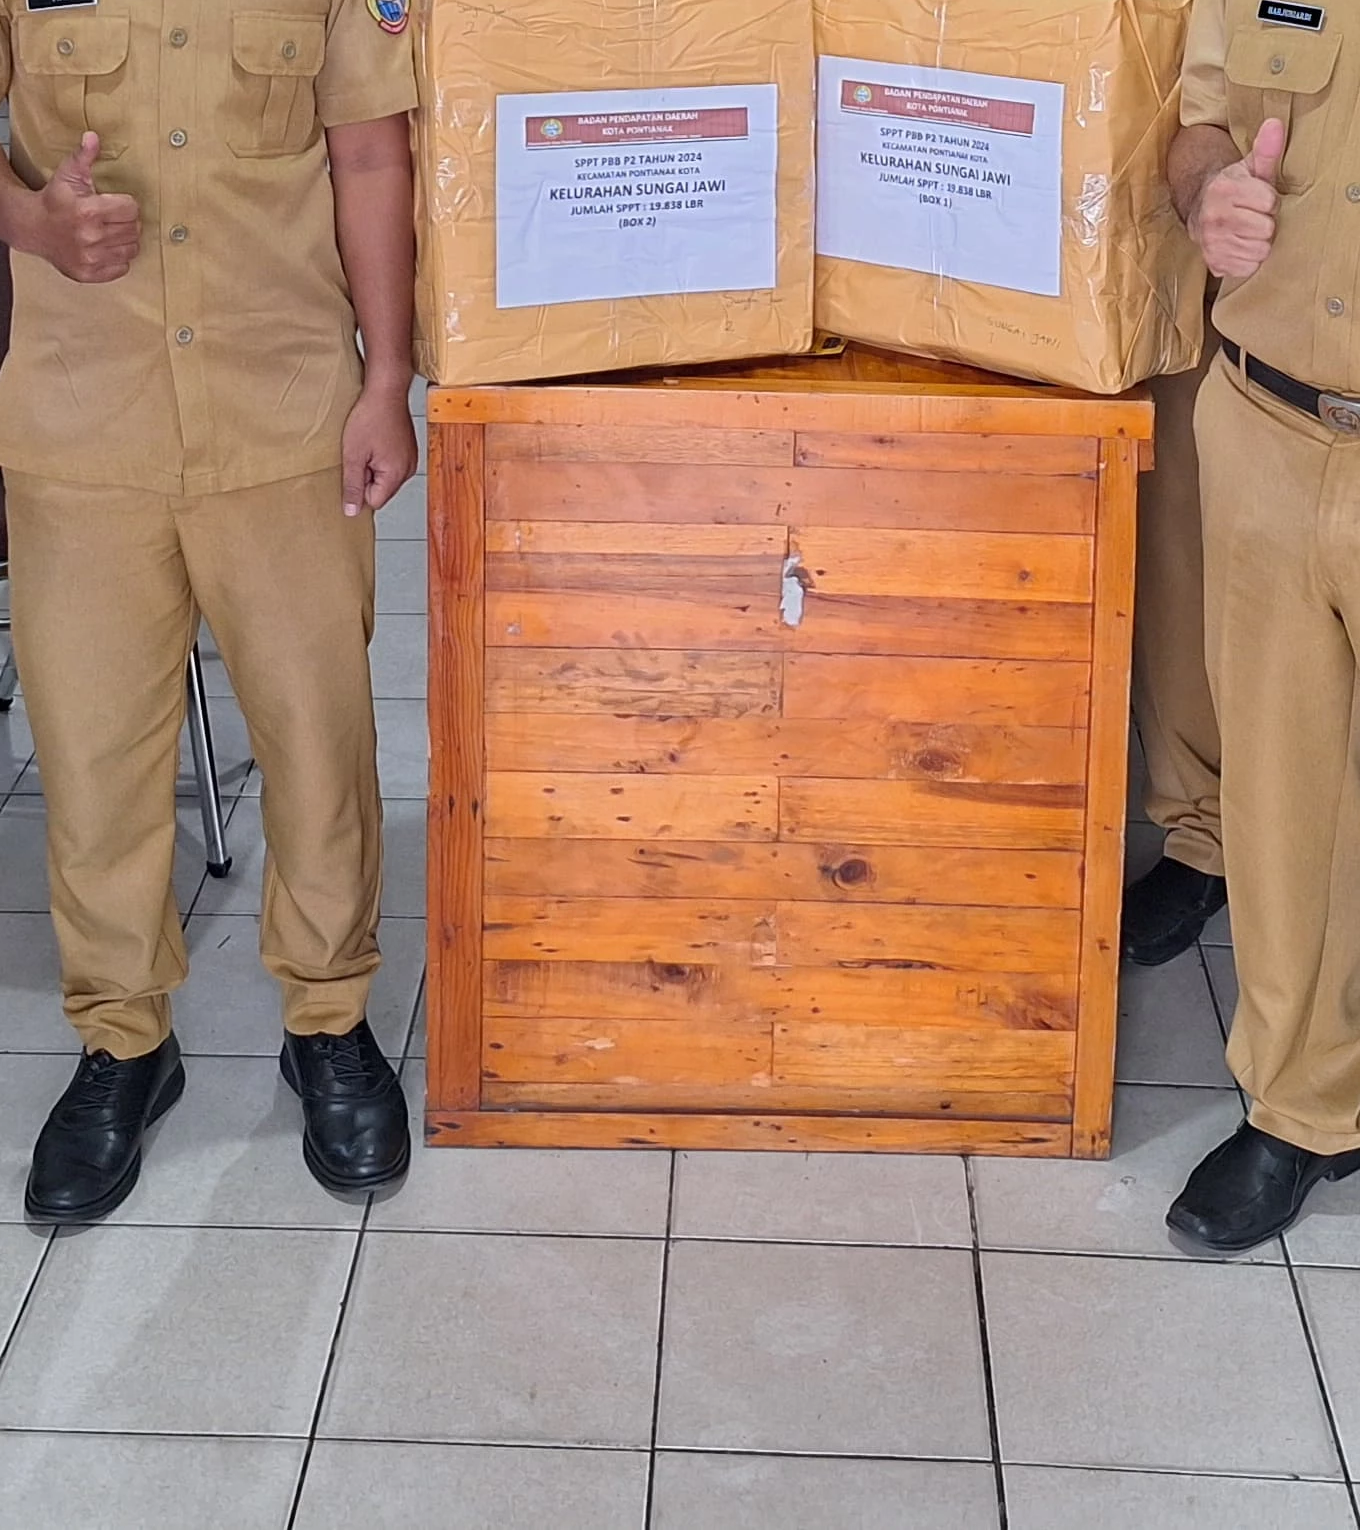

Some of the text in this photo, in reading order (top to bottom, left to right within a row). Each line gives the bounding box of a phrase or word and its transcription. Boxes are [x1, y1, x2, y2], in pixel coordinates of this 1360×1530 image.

[884, 87, 961, 105] BADAN PENDAPATAN
[906, 102, 968, 117] KOTA PONTIANAK
[578, 111, 699, 126] BADAN PENDAPATAN DAERAH
[602, 125, 673, 136] KOTA PONTIANAK
[880, 127, 990, 151] SPPT PBB P2 TAHUN 2024
[882, 141, 968, 162] KECAMATAN PONTIANAK
[575, 152, 703, 168] SPPT PBB P2 TAHUN 2024
[577, 167, 701, 181] KECAMATAN PONTIANAK KOTA
[860, 151, 1011, 186] KELURAHAN SUNGAI JAWI
[550, 179, 726, 201] KELURAHAN SUNGAI JAWI
[879, 172, 992, 200] JUMLAH SPPT LBR
[570, 199, 704, 216] JUMLAH SPPT 19.838 LBR
[919, 193, 941, 207] (BOX
[619, 216, 657, 229] (BOX 2)
